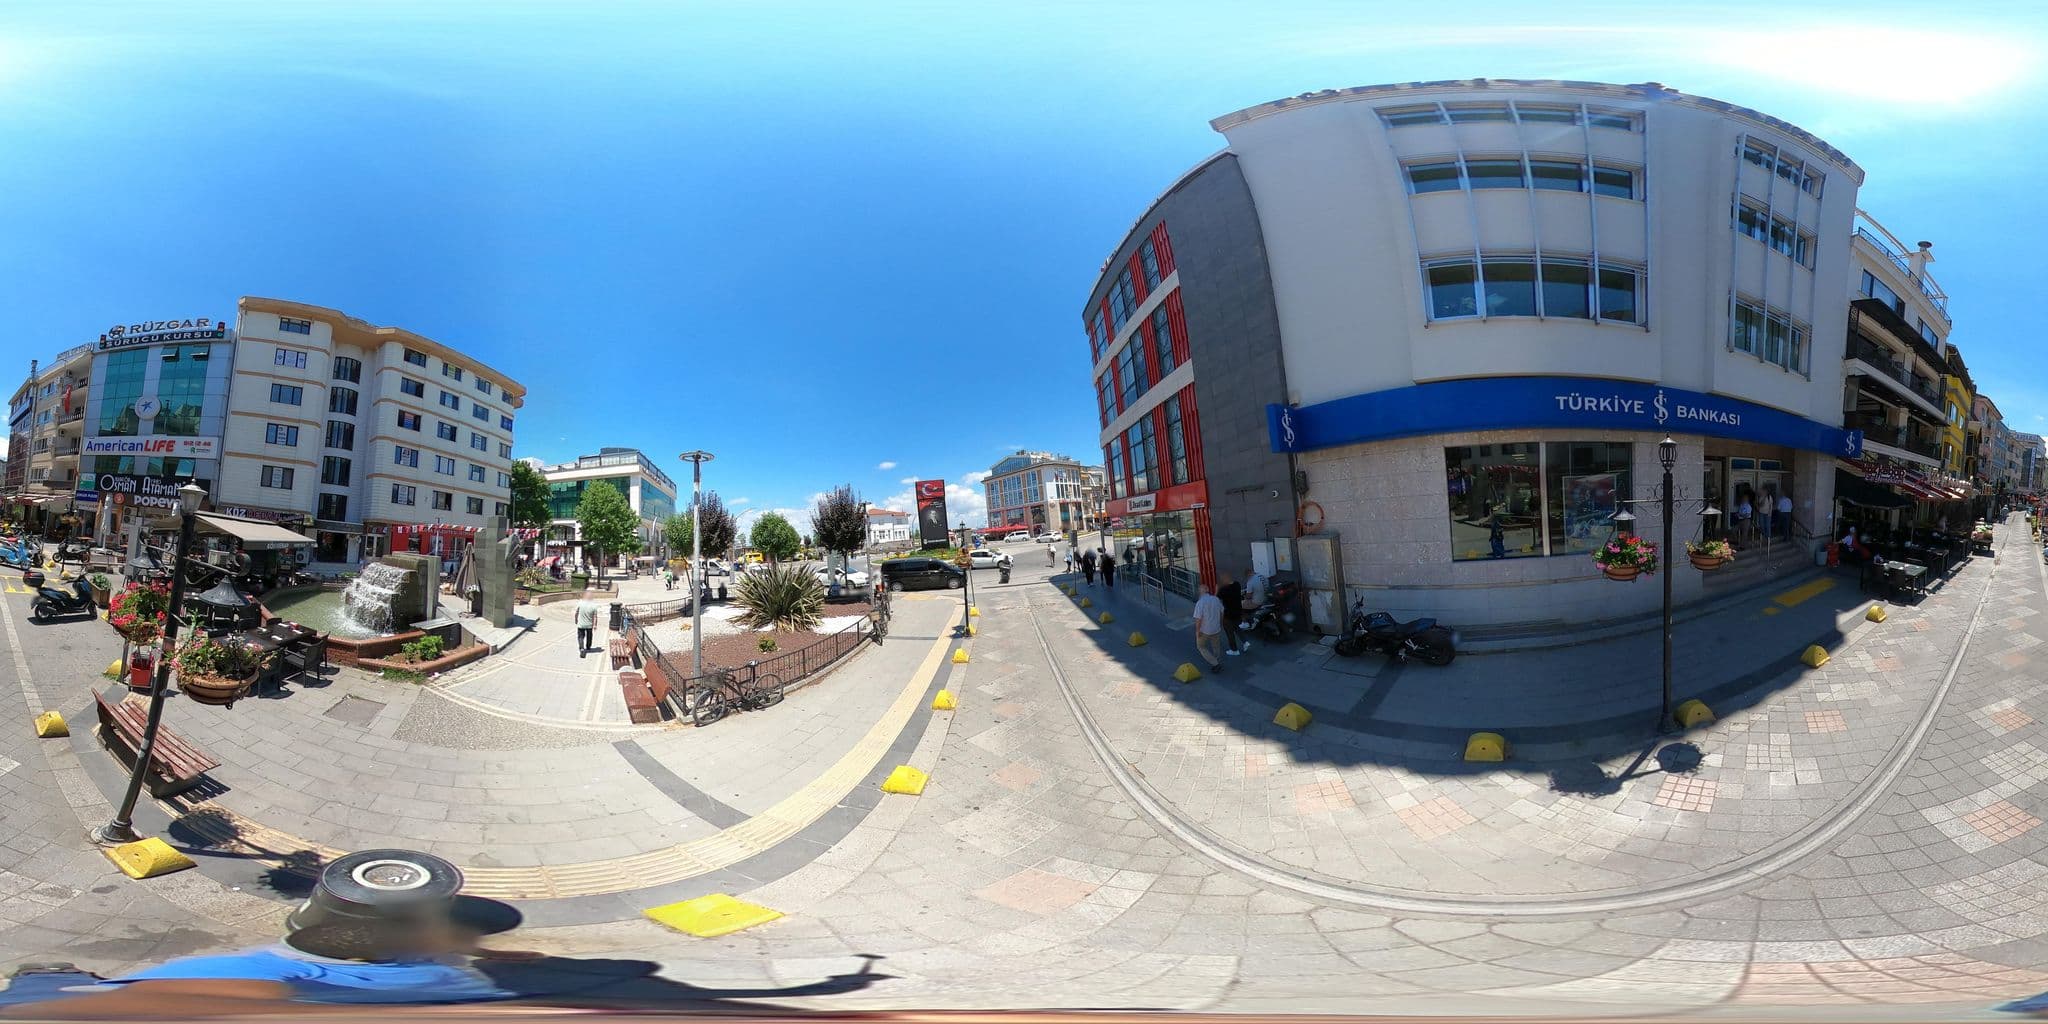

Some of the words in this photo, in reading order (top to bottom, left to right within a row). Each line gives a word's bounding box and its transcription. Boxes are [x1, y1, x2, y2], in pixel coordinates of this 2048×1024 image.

[130, 318, 210, 334] RÜZGAR
[163, 331, 213, 340] KURSU
[1555, 393, 1644, 414] TÜRKİYE
[1676, 405, 1741, 426] BANKASI
